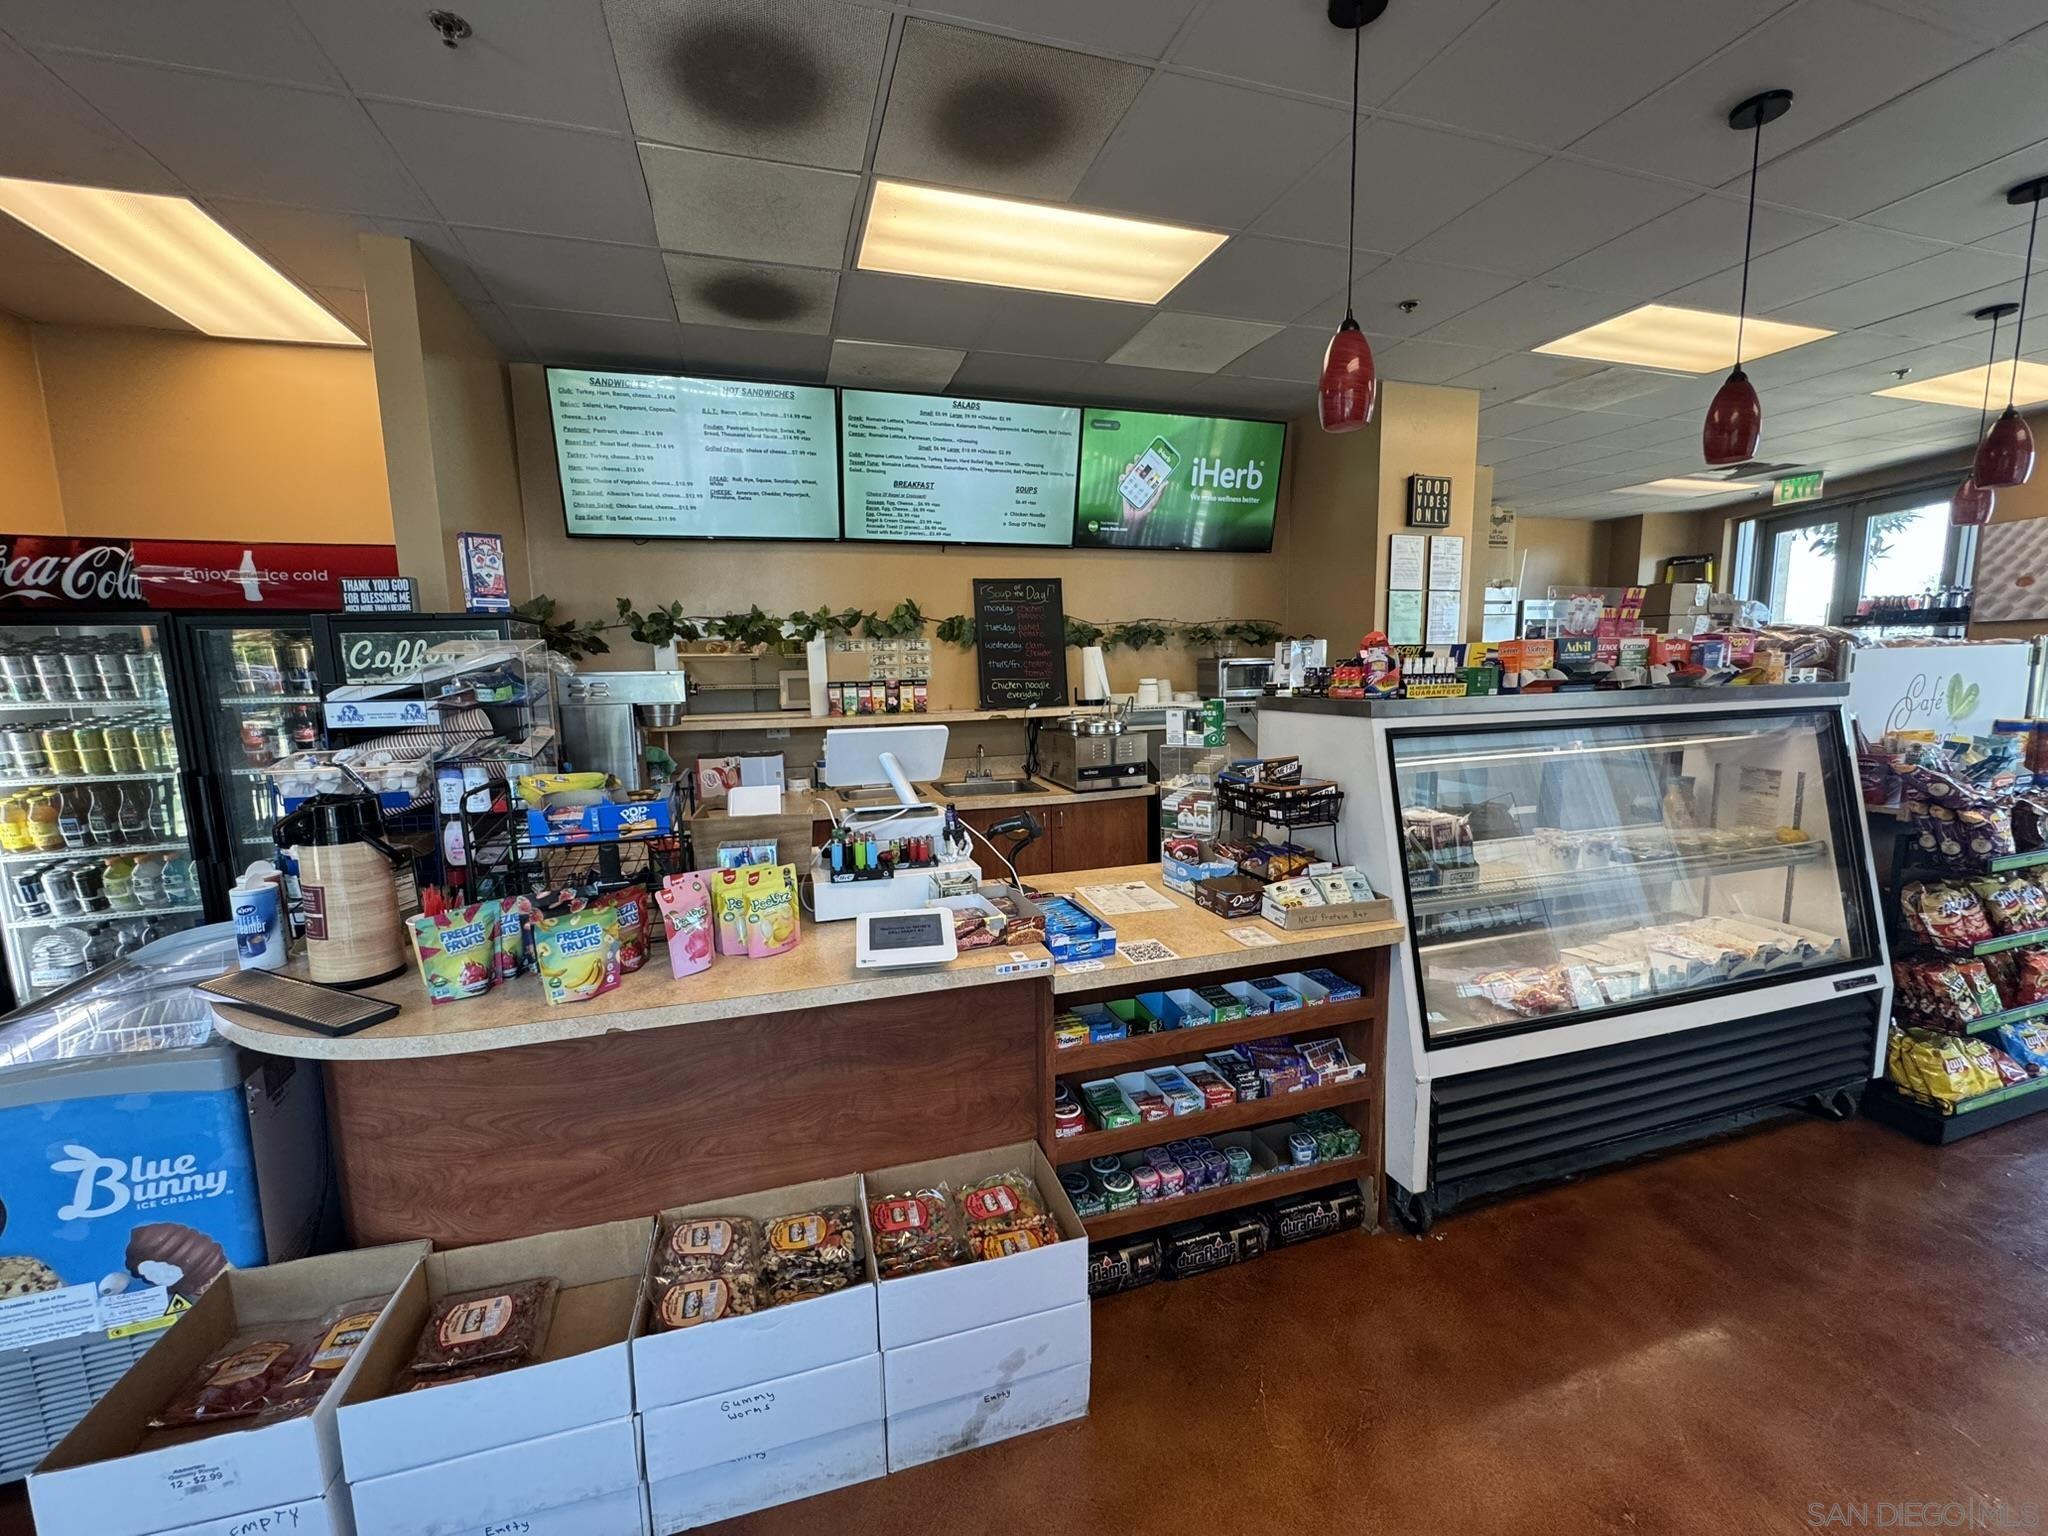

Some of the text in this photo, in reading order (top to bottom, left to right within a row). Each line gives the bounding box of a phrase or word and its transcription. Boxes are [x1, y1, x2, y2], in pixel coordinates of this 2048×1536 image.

[742, 388, 795, 399] SANDWICHES
[952, 401, 980, 410] SALADS
[1191, 457, 1263, 489] iHerb
[894, 480, 934, 490] BREAKFAST
[1016, 486, 1038, 494] SOUPS
[1417, 480, 1448, 494] GOOD
[1781, 475, 1823, 501] EXIT
[1417, 496, 1448, 508] VIBES
[1416, 508, 1448, 522] ONLY
[473, 537, 496, 548] BICYCLE
[183, 568, 328, 585] enjoy ice cold
[342, 579, 409, 591] THANK YOU GOD
[343, 592, 411, 603] FOR BLESSING ME
[986, 586, 1011, 599] Soup
[984, 605, 1014, 614] monday
[984, 623, 1015, 633] tuesday
[984, 642, 1022, 650] wednesday
[1565, 641, 1591, 652] Advil
[1728, 635, 1750, 647] Pepto
[992, 681, 1050, 690] Chicken noodle
[1409, 688, 1464, 696] GUARANTEED!
[752, 891, 792, 912] Peelerz
[617, 901, 638, 916] EZIE
[439, 922, 485, 943] FREEZIE
[556, 923, 602, 944] FREEZIE
[443, 933, 486, 953] FRUITS
[560, 936, 601, 956] FRUITS
[1331, 992, 1360, 1001] mentos
[1057, 1036, 1082, 1045] Trident
[136, 1194, 204, 1211] ICE CREAM
[1281, 1211, 1339, 1236] duraflame
[1177, 1242, 1237, 1269] duraflame
[721, 1393, 775, 1412] Gummy
[984, 1390, 1010, 1403] Empty
[170, 1480, 184, 1489] 12
[194, 1472, 223, 1485] $2.99
[229, 1507, 299, 1536] EMPTY
